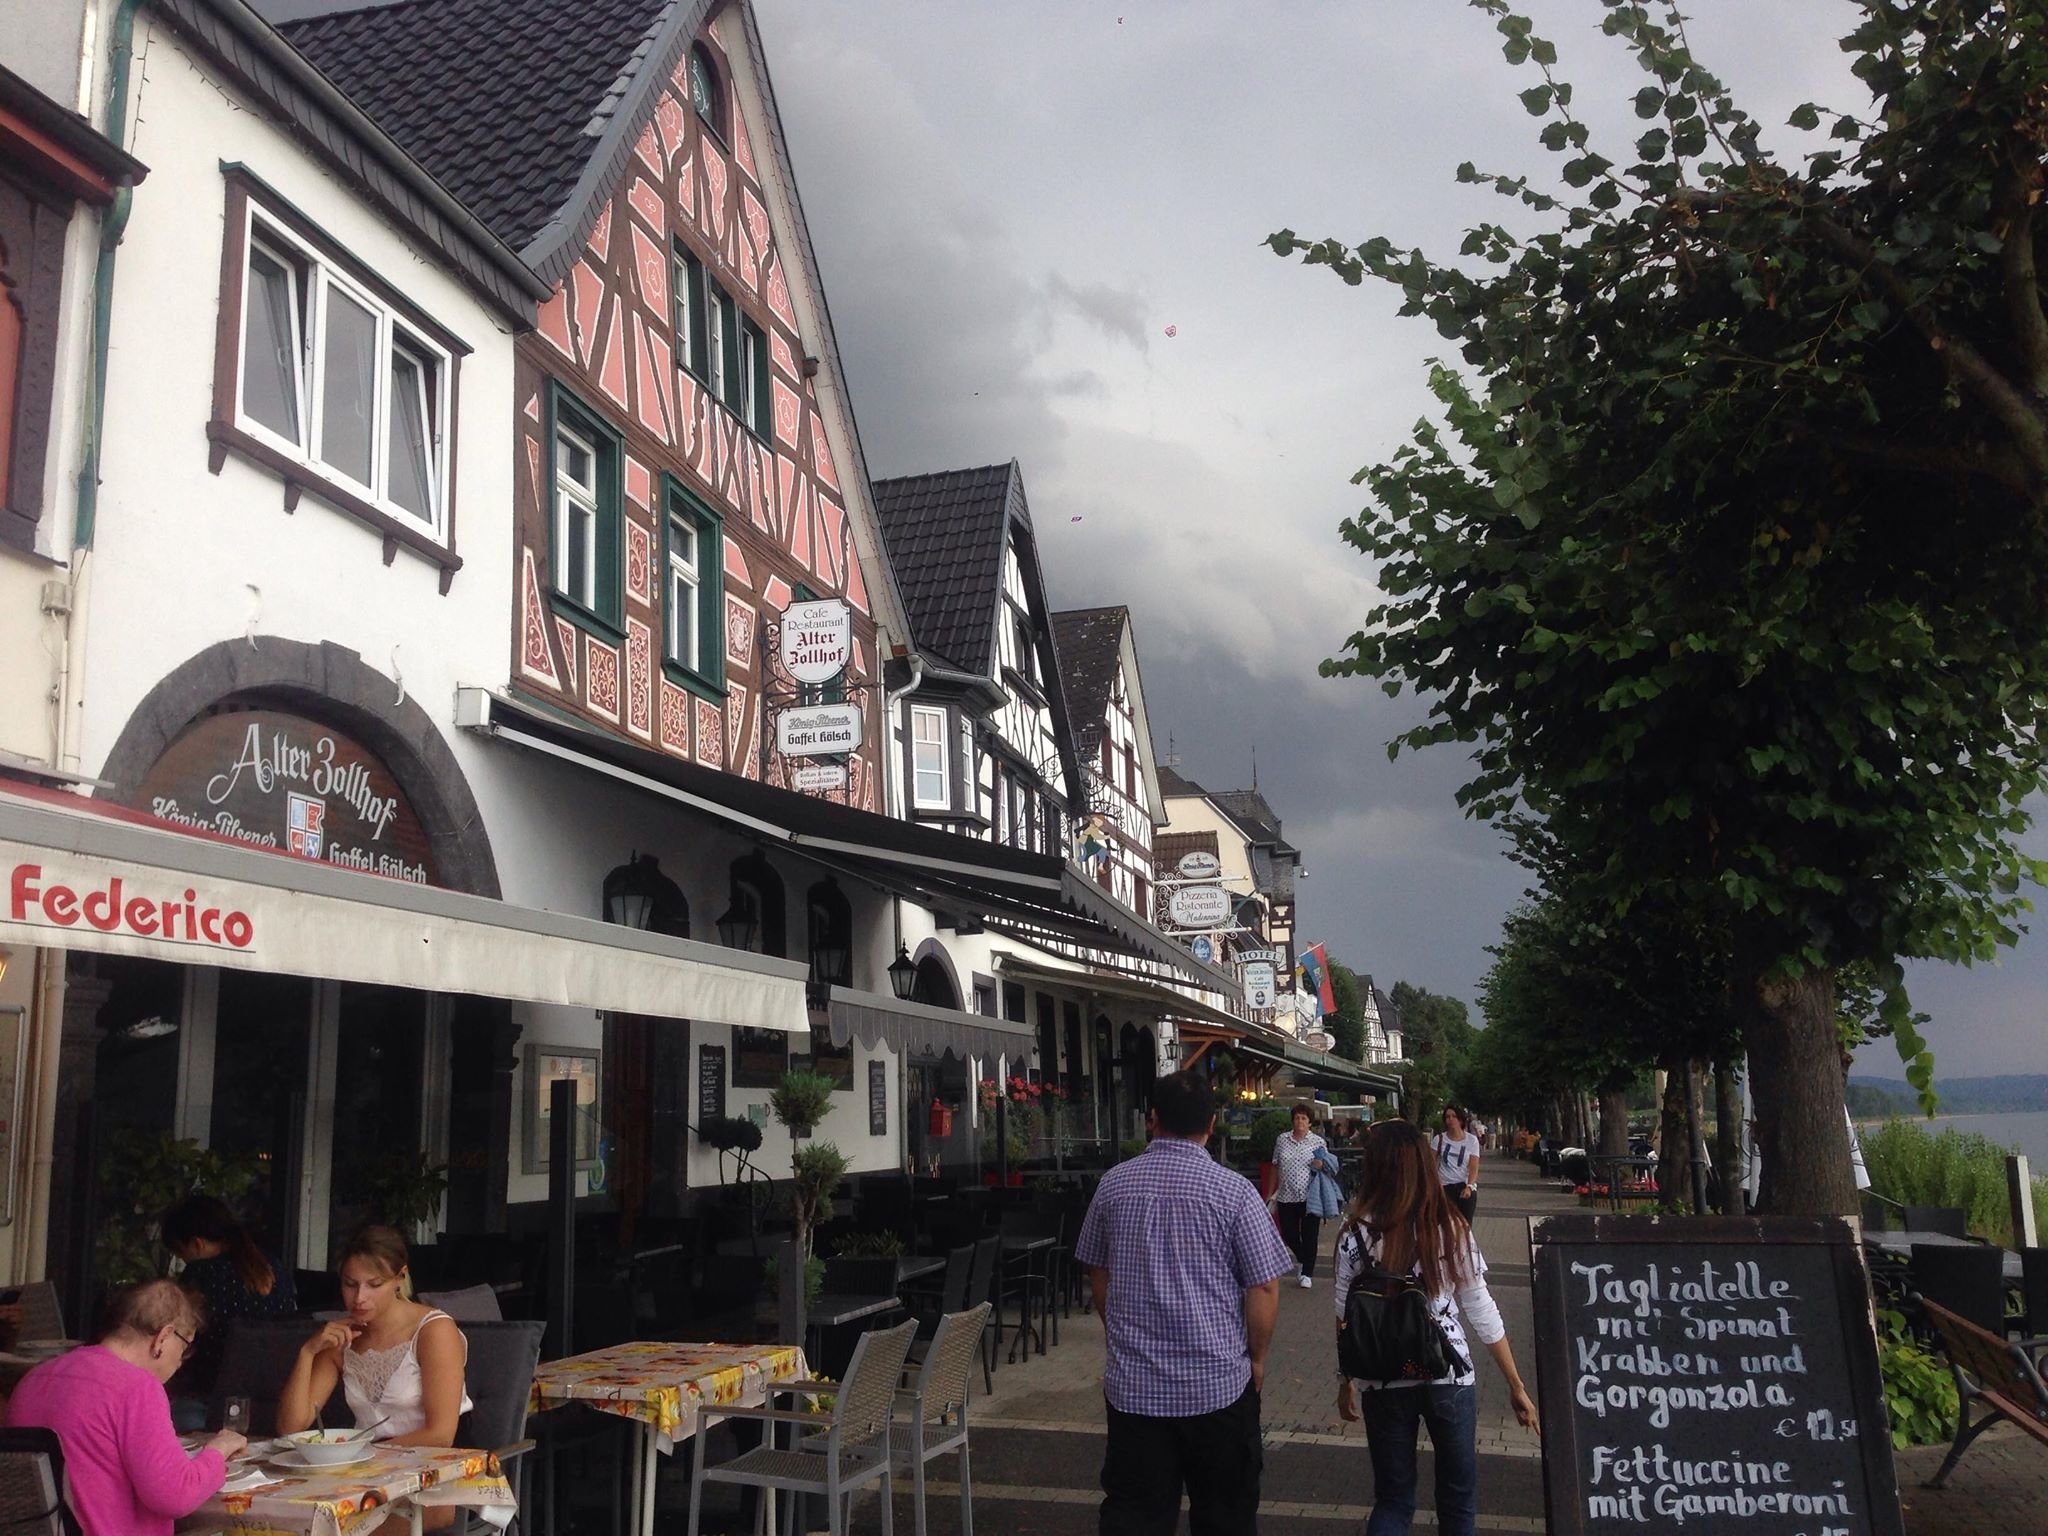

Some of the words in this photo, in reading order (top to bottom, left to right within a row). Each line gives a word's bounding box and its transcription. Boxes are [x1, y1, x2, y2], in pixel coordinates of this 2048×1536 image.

[788, 617, 844, 631] Restaurant
[797, 632, 836, 649] Alter
[789, 647, 844, 668] Zollhof
[788, 732, 817, 745] Gaffel
[820, 730, 851, 743] Kölsch
[206, 723, 310, 805] Alter
[312, 737, 397, 841] Zollhof
[1176, 901, 1223, 911] Ristorante
[1181, 891, 1217, 901] Pizzeria
[1238, 951, 1278, 962] HOTEL
[1570, 1260, 1800, 1317] Tagliatelle
[1680, 1305, 1803, 1341] Spinat
[1576, 1336, 1720, 1377] Krabben
[1740, 1344, 1808, 1375] und
[1576, 1374, 1795, 1429] Gorgonzola
[1590, 1443, 1795, 1487] Fettuccine
[1588, 1485, 1651, 1523] mit
[1653, 1479, 1858, 1526] Gamberoni
